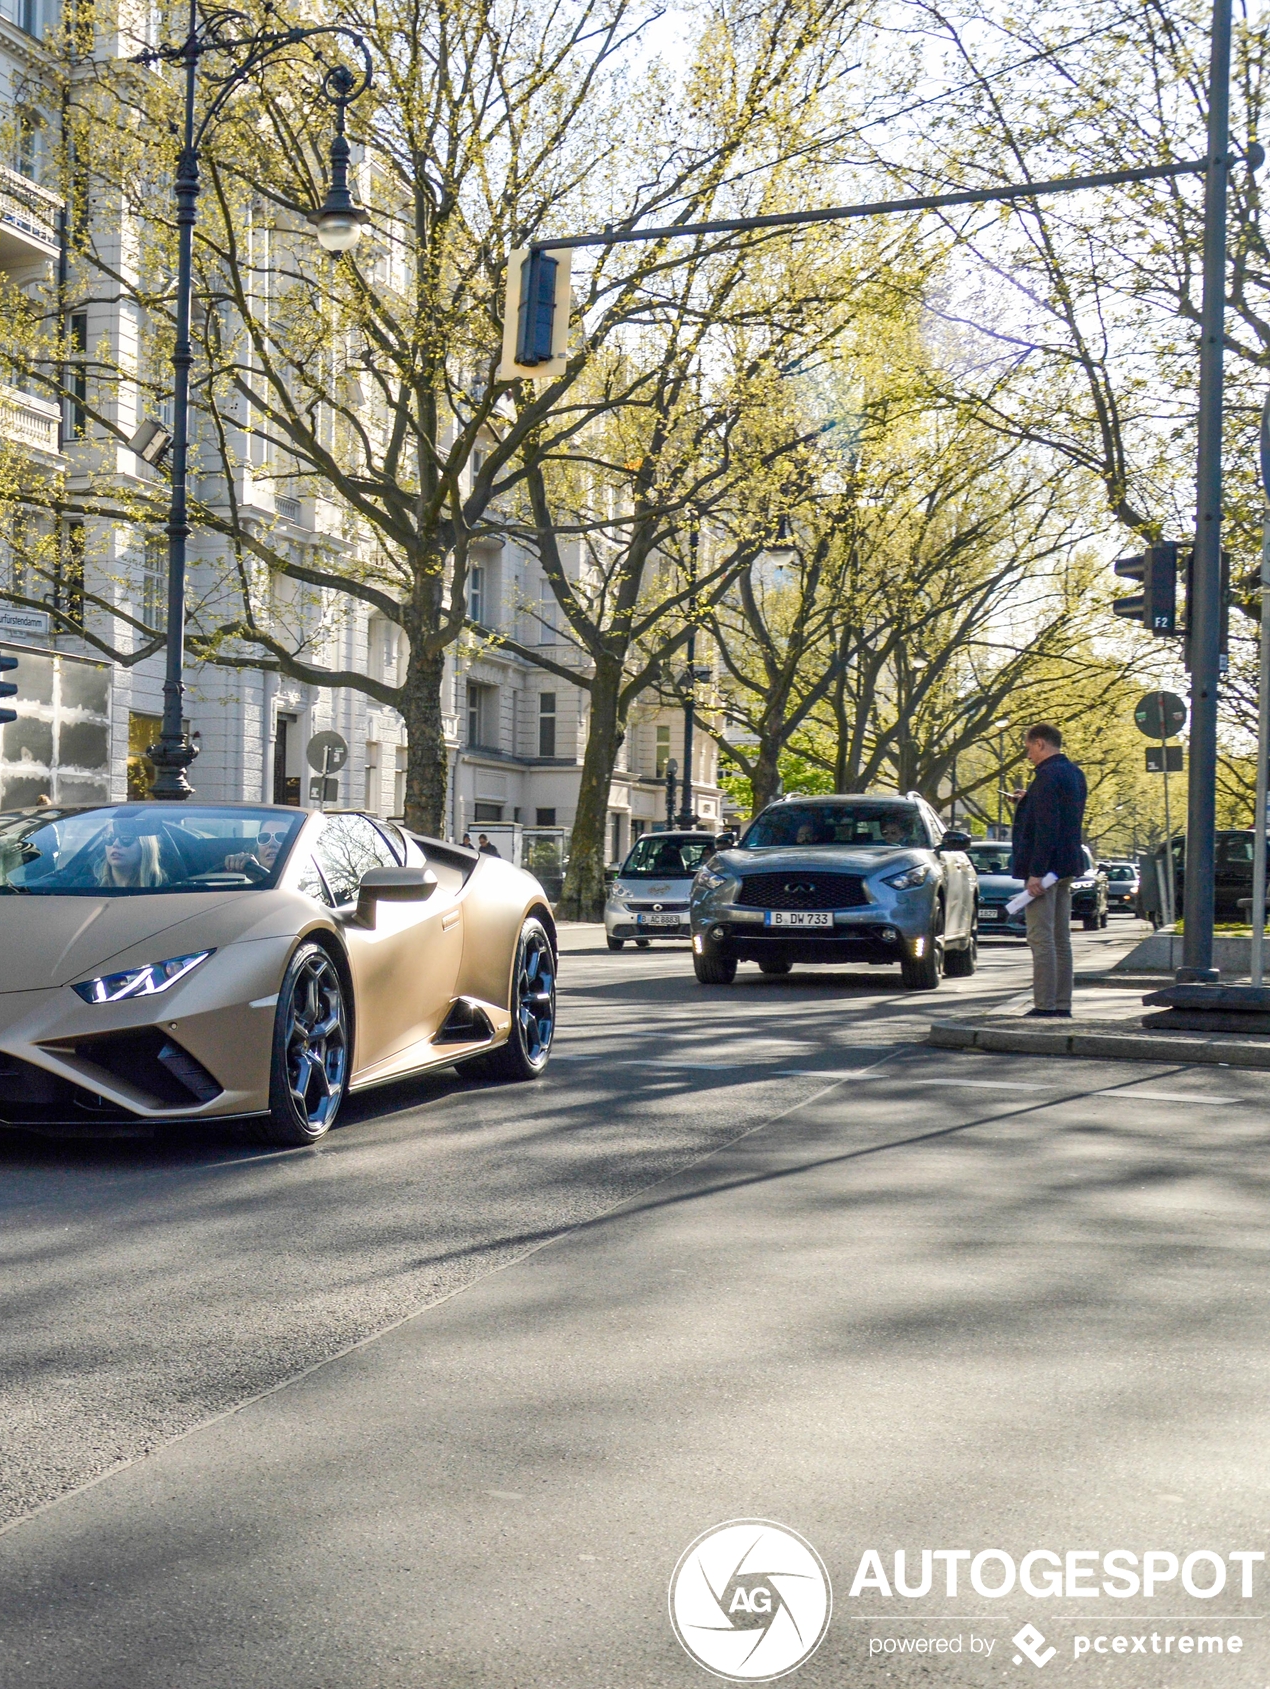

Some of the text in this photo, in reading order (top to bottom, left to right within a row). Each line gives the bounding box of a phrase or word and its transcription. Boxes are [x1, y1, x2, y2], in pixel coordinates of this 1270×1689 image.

[1155, 617, 1168, 628] F2
[775, 913, 828, 924] B DW 733
